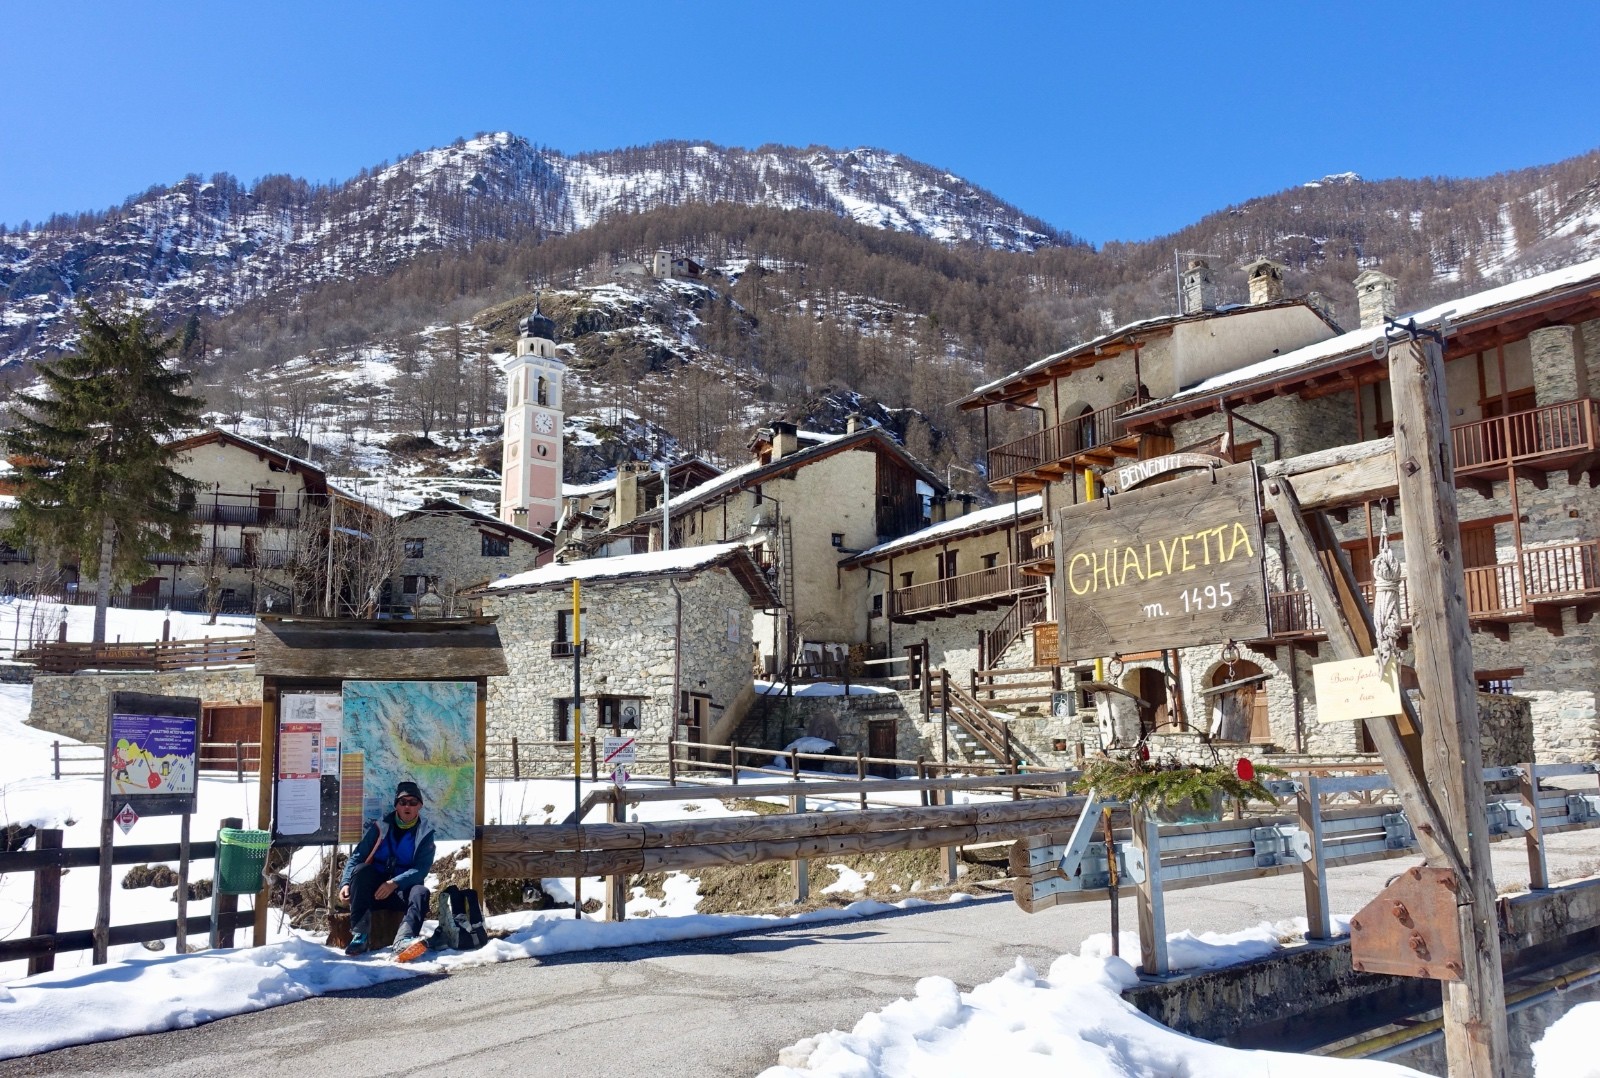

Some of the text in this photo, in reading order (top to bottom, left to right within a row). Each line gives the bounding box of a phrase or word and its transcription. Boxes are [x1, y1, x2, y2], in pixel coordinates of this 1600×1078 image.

[1119, 456, 1182, 490] BENVENUTI
[1068, 522, 1254, 596] CHIALVETTA
[1179, 582, 1233, 613] 1495
